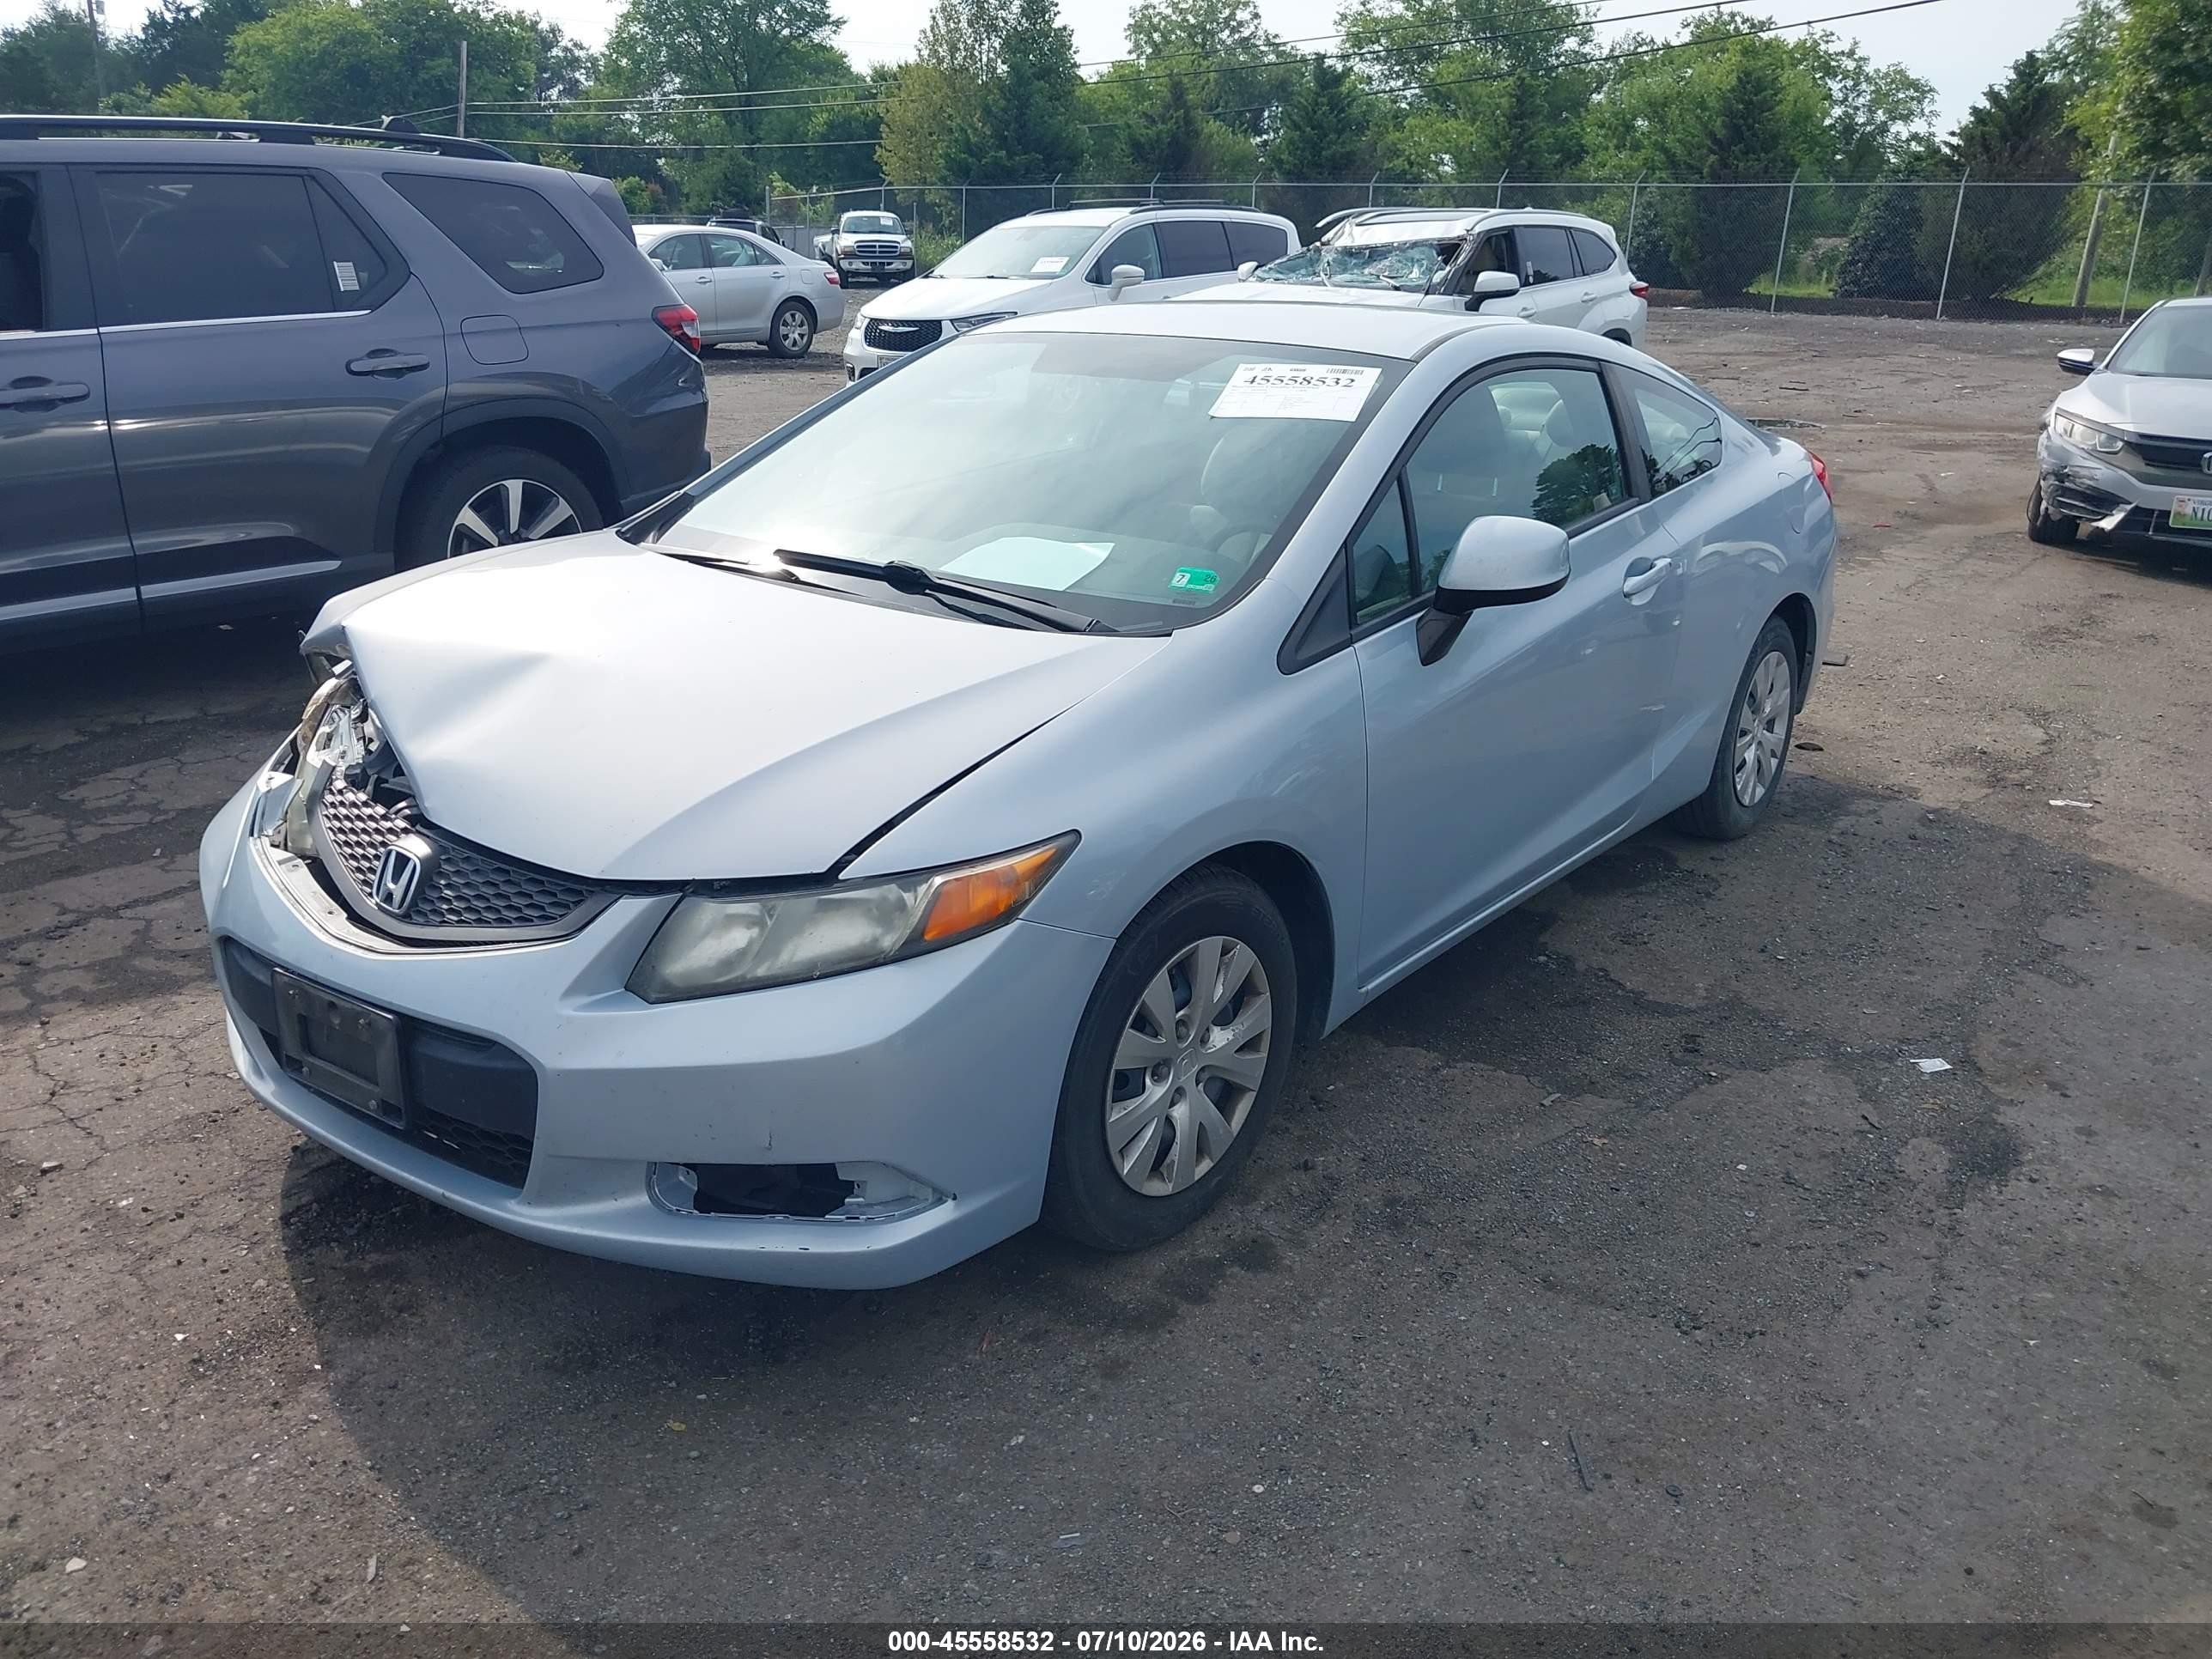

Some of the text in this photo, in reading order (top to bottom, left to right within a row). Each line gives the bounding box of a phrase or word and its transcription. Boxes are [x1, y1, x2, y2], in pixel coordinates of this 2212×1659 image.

[1243, 375, 1355, 387] 45558532
[1176, 574, 1217, 583] 7 26
